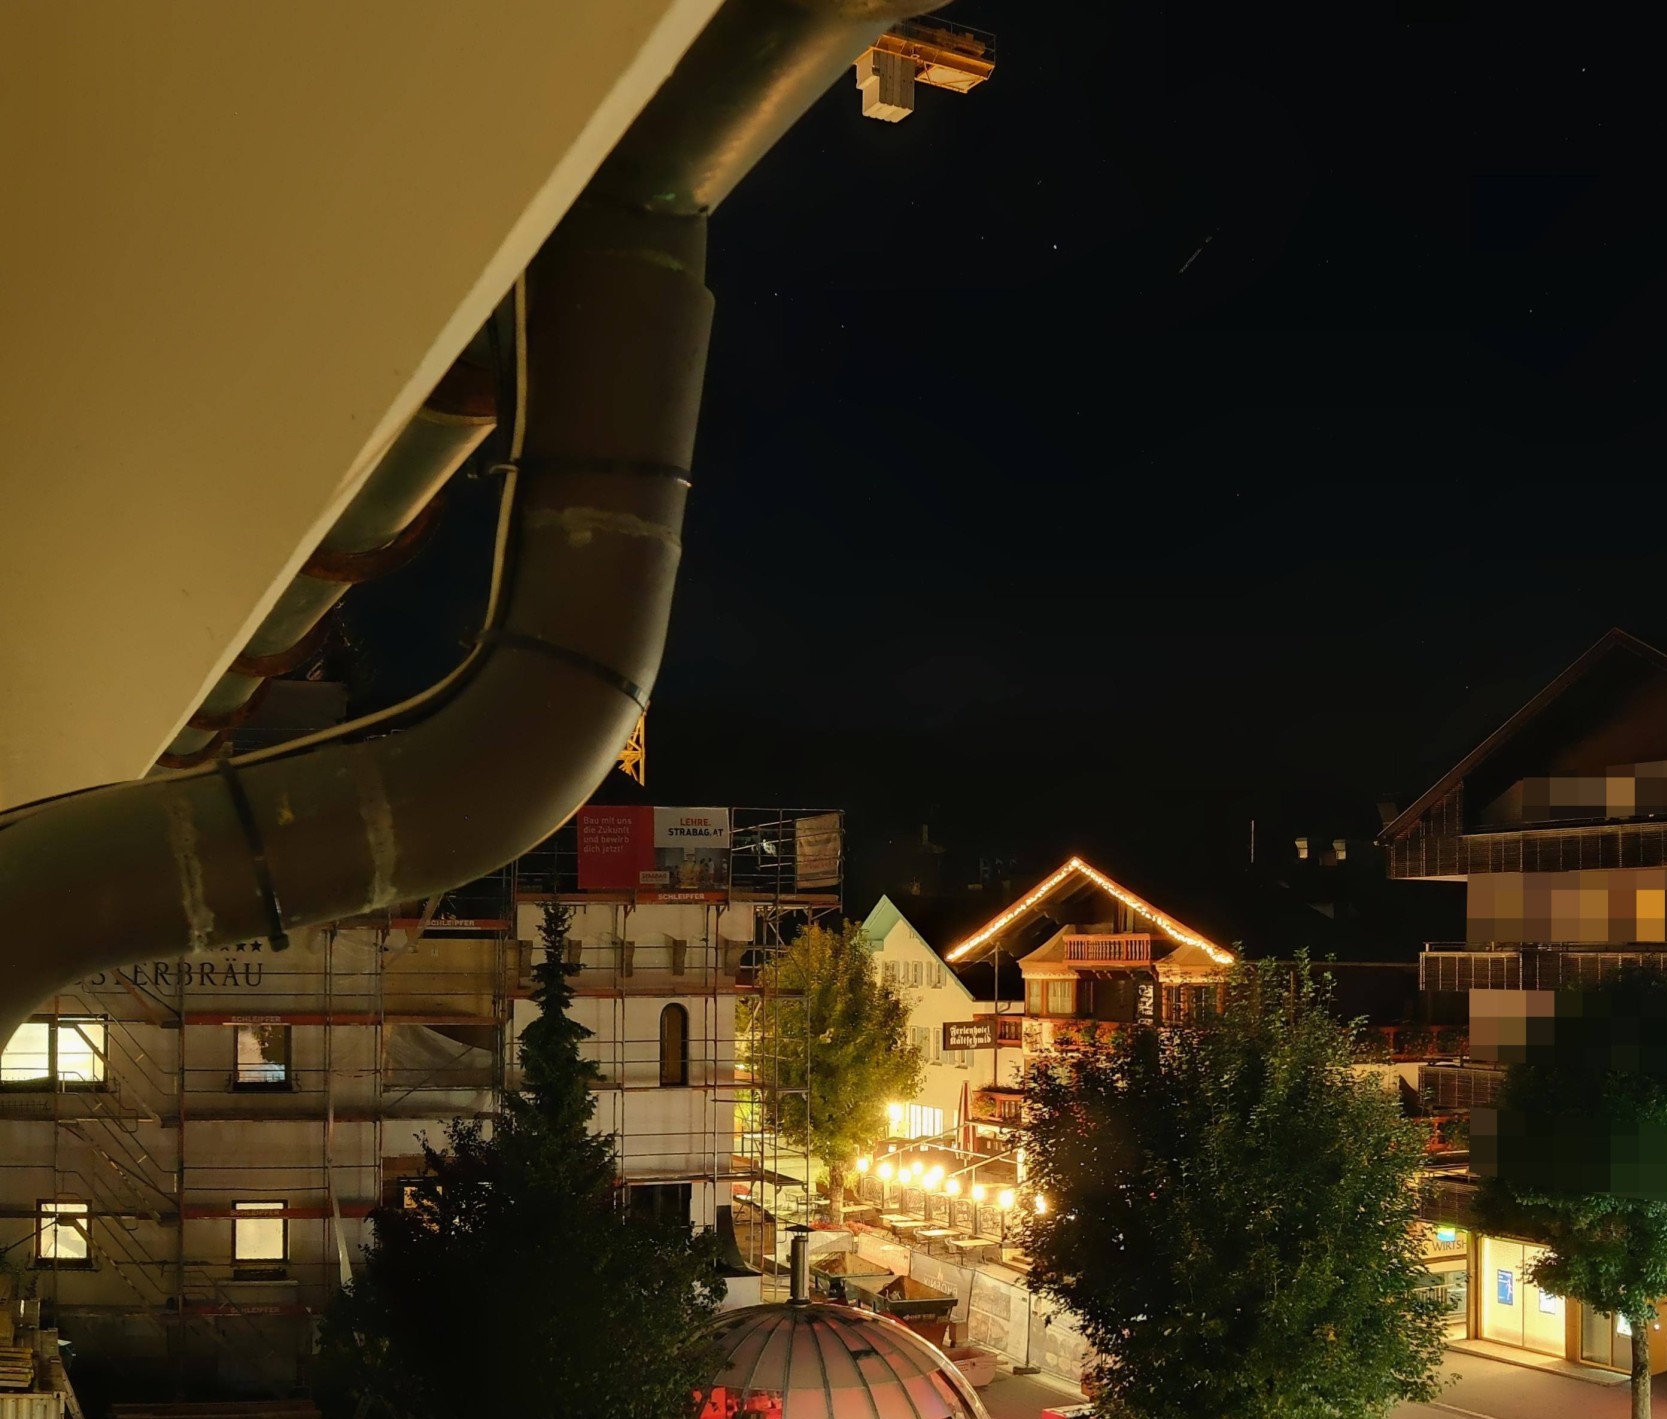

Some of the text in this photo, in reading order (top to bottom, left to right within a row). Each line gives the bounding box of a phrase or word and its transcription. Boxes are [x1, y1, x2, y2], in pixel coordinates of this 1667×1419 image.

[583, 816, 599, 825] Bau
[601, 816, 615, 825] mit
[680, 818, 712, 827] LEHRE.
[583, 825, 630, 834] die Zukunft
[583, 835, 630, 844] und bewirb
[583, 845, 624, 855] dich jetzt!
